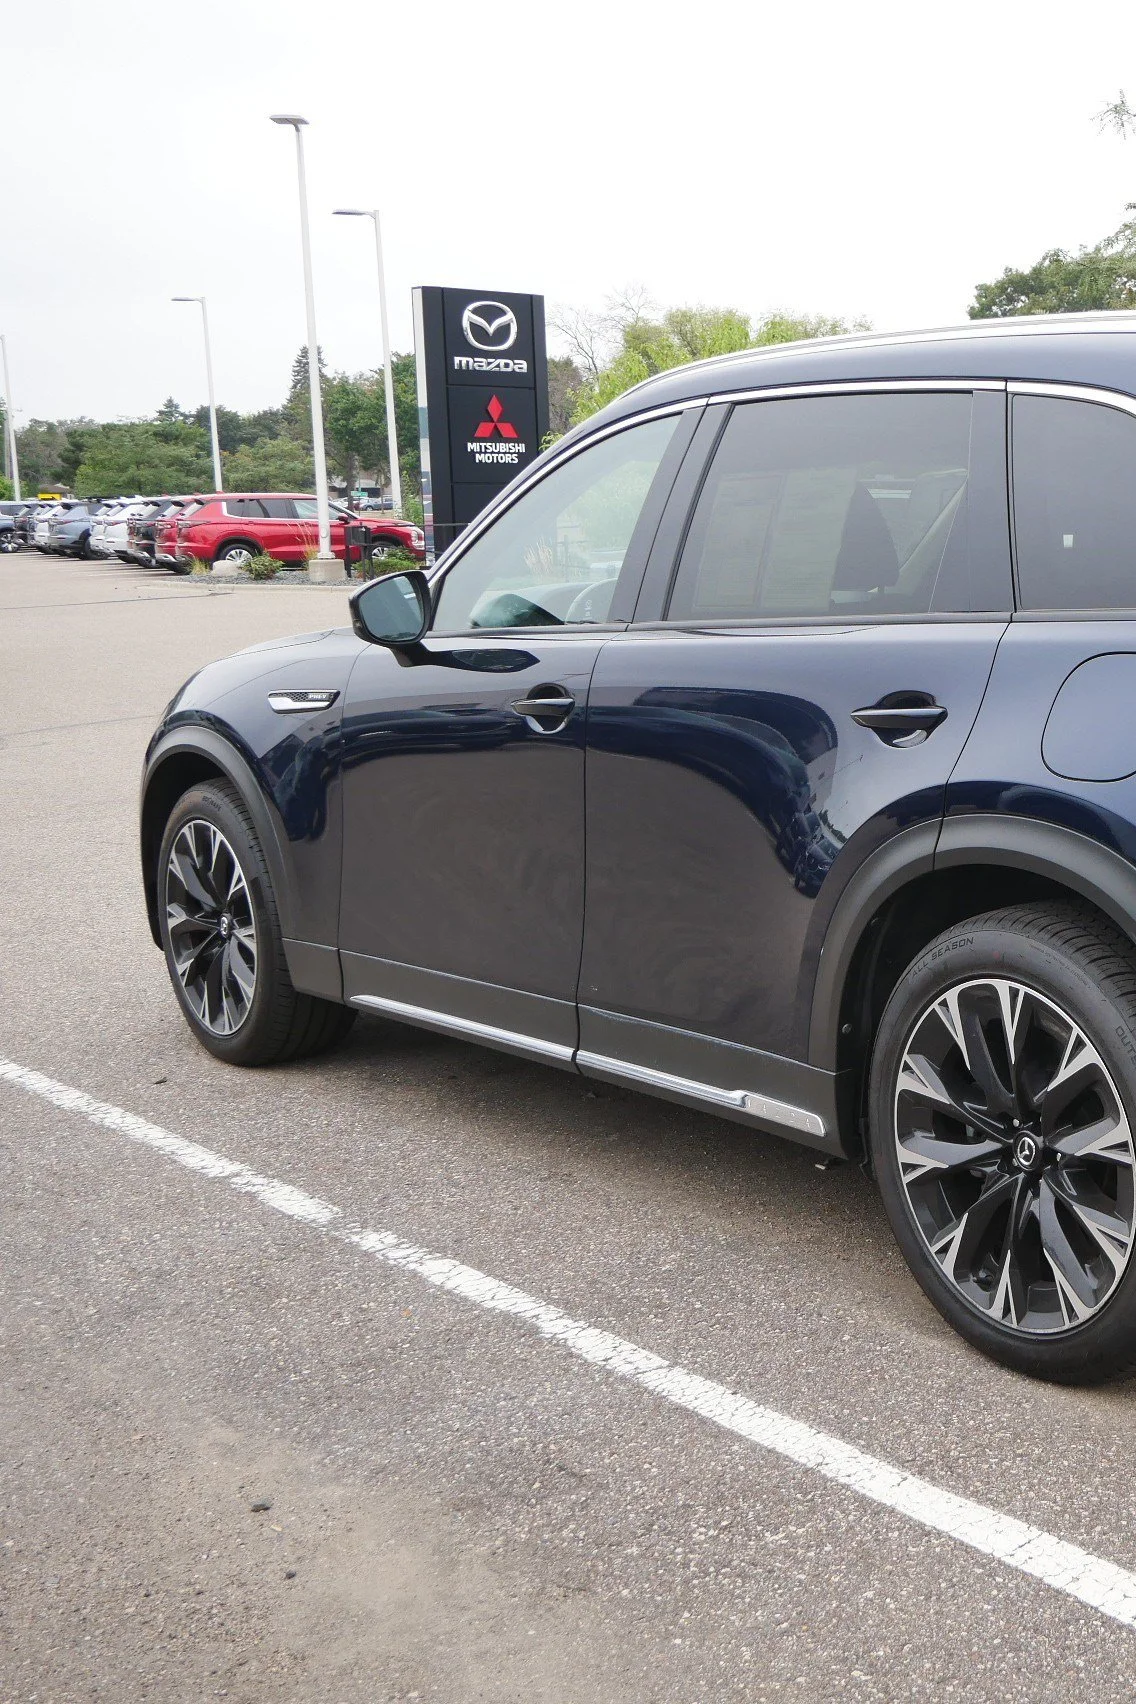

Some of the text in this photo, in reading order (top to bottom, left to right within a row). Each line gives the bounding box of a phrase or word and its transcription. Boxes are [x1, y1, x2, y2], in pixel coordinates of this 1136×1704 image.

[467, 442, 526, 453] MITSUBISHI
[475, 453, 519, 464] MOTORS
[931, 936, 974, 961] SEASON
